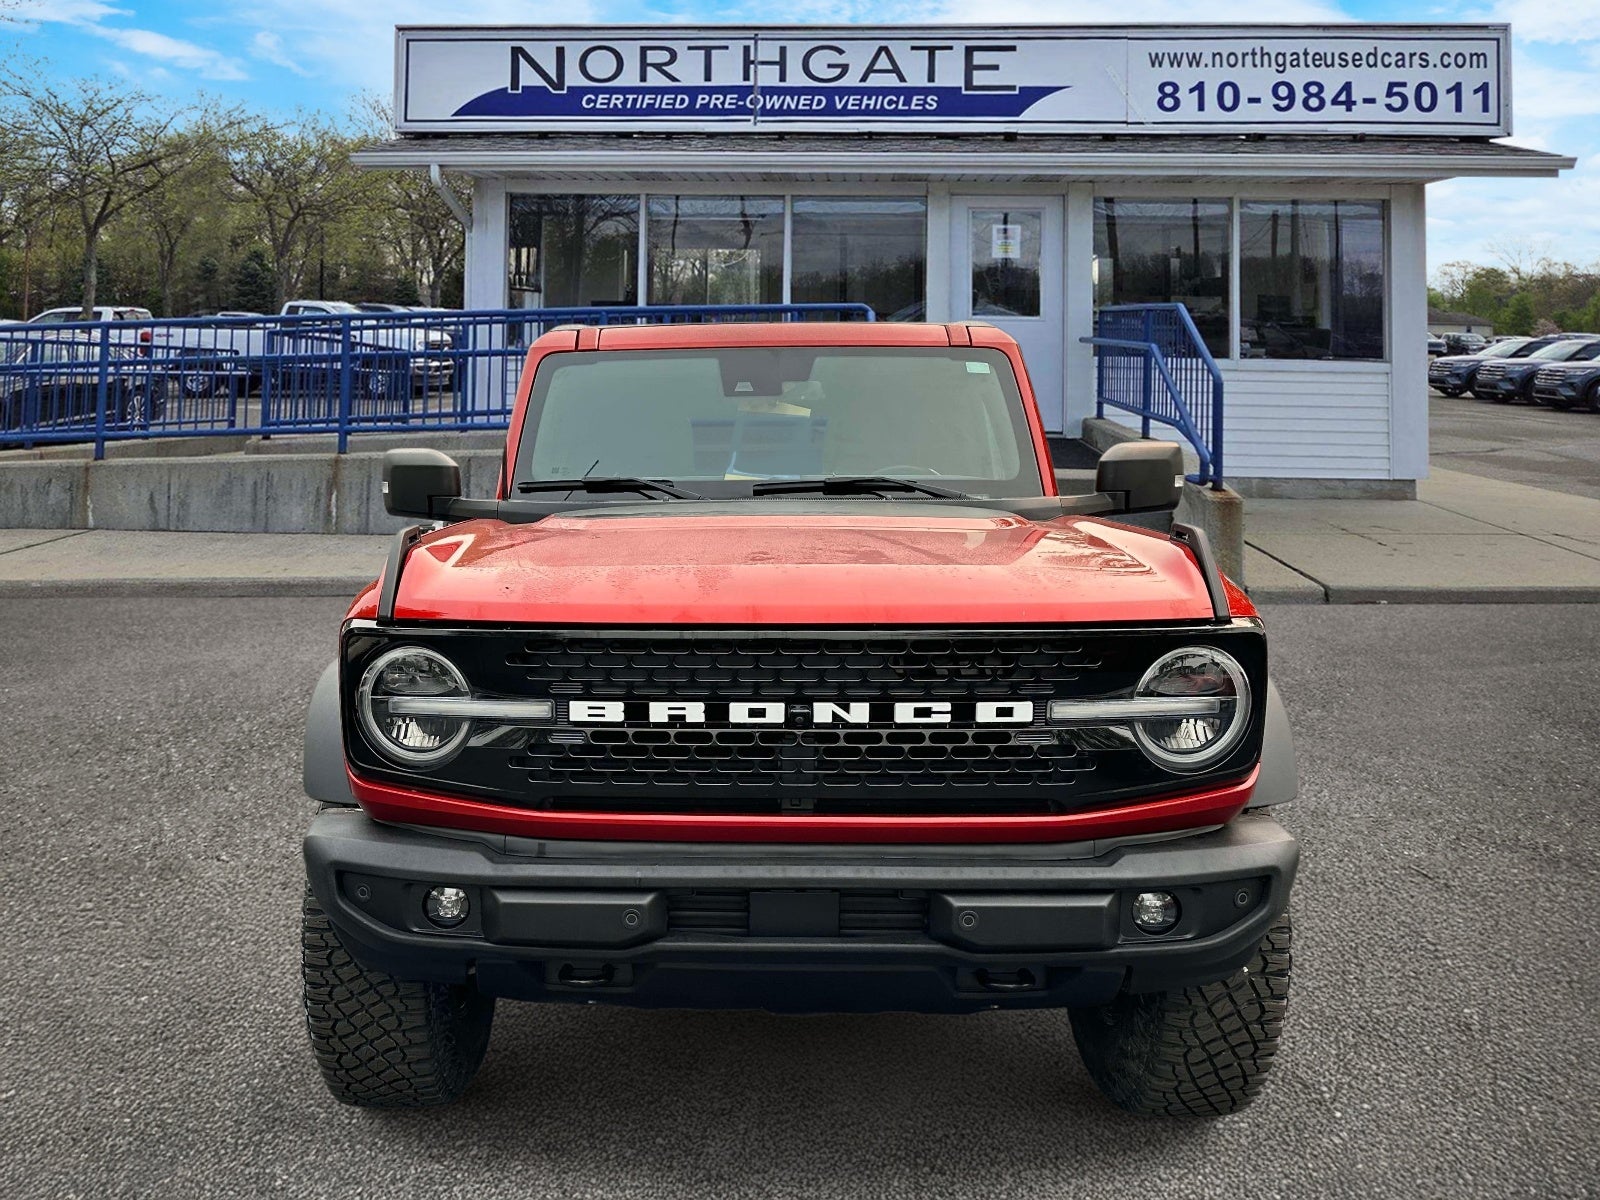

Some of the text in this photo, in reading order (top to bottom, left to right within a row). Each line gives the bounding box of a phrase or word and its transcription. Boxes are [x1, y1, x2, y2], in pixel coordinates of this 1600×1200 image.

[510, 44, 1018, 92] NORTHGATE
[1148, 46, 1489, 73] www.northgateusedcars.com
[581, 93, 939, 111] CERTIFIED PRE-OWNED VEHICLES
[1155, 80, 1491, 114] 810-984-5011
[568, 699, 1035, 724] BRONCO
